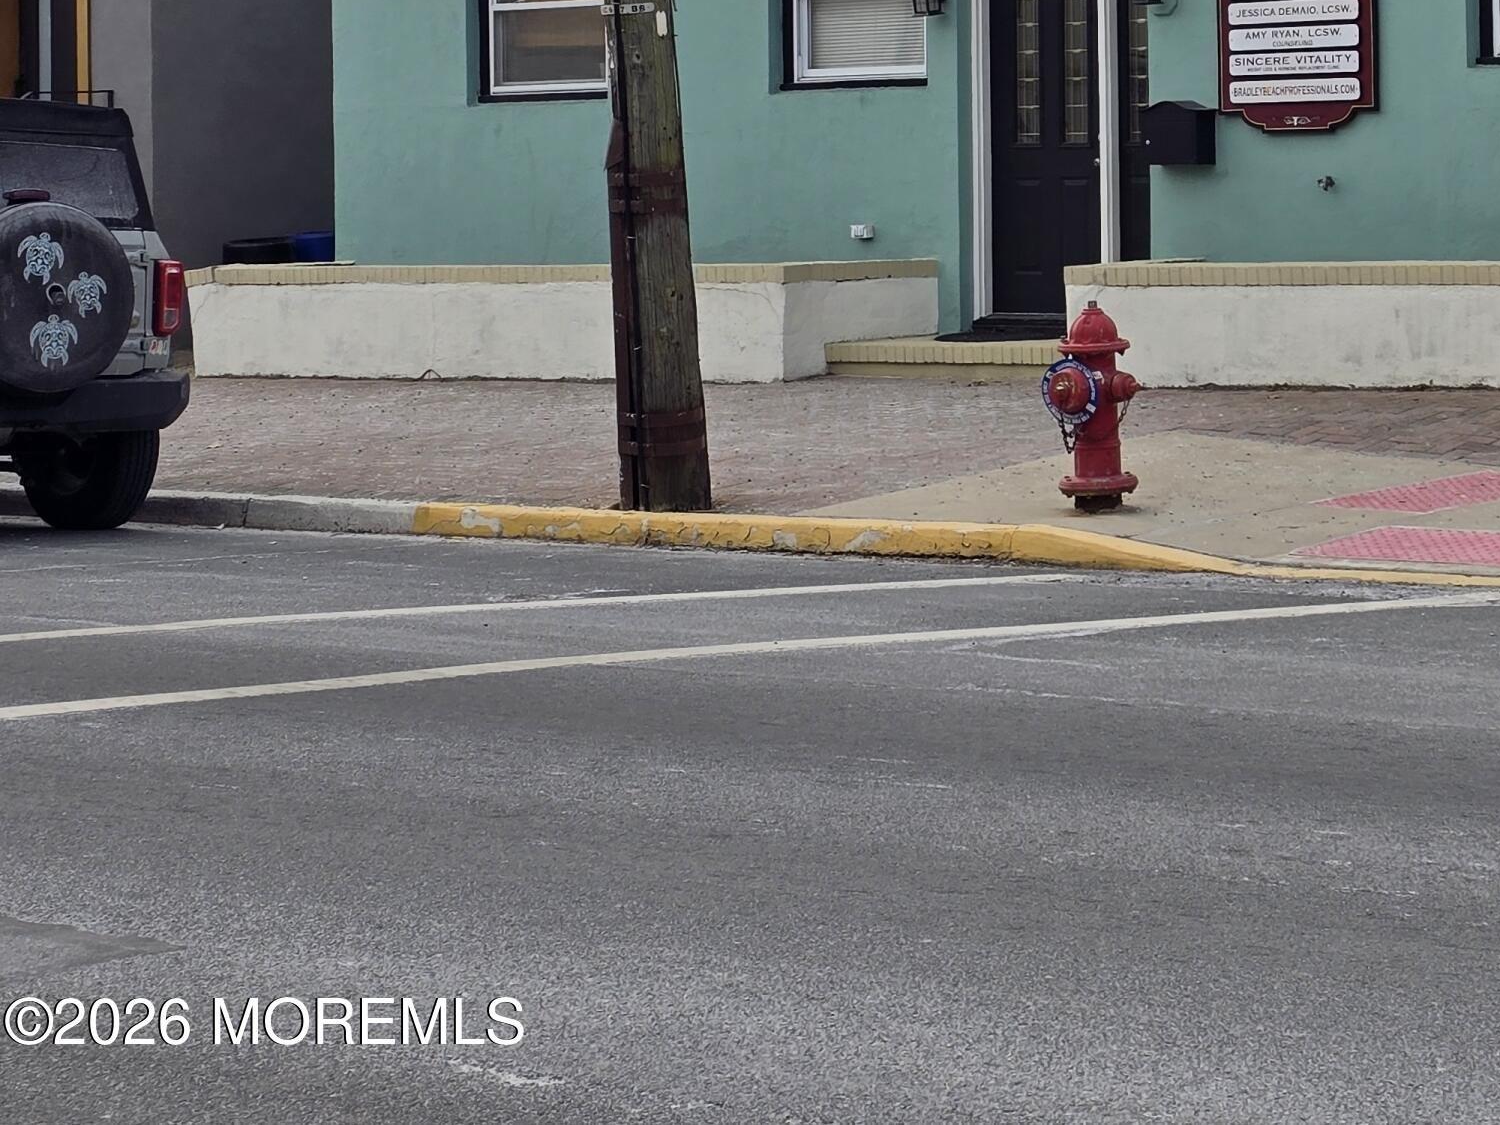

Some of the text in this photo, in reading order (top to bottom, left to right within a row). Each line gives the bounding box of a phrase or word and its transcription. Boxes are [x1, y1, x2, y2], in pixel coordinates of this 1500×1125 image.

[1236, 8, 1276, 18] JESSICA
[1278, 5, 1319, 16] DEMAIO,
[1245, 30, 1267, 40] AMY
[1271, 29, 1303, 39] RYAN,
[1234, 54, 1352, 67] SINCERE VITALITY
[1233, 83, 1356, 97] BRADLEYBEACHPROFESSIONALS.COM
